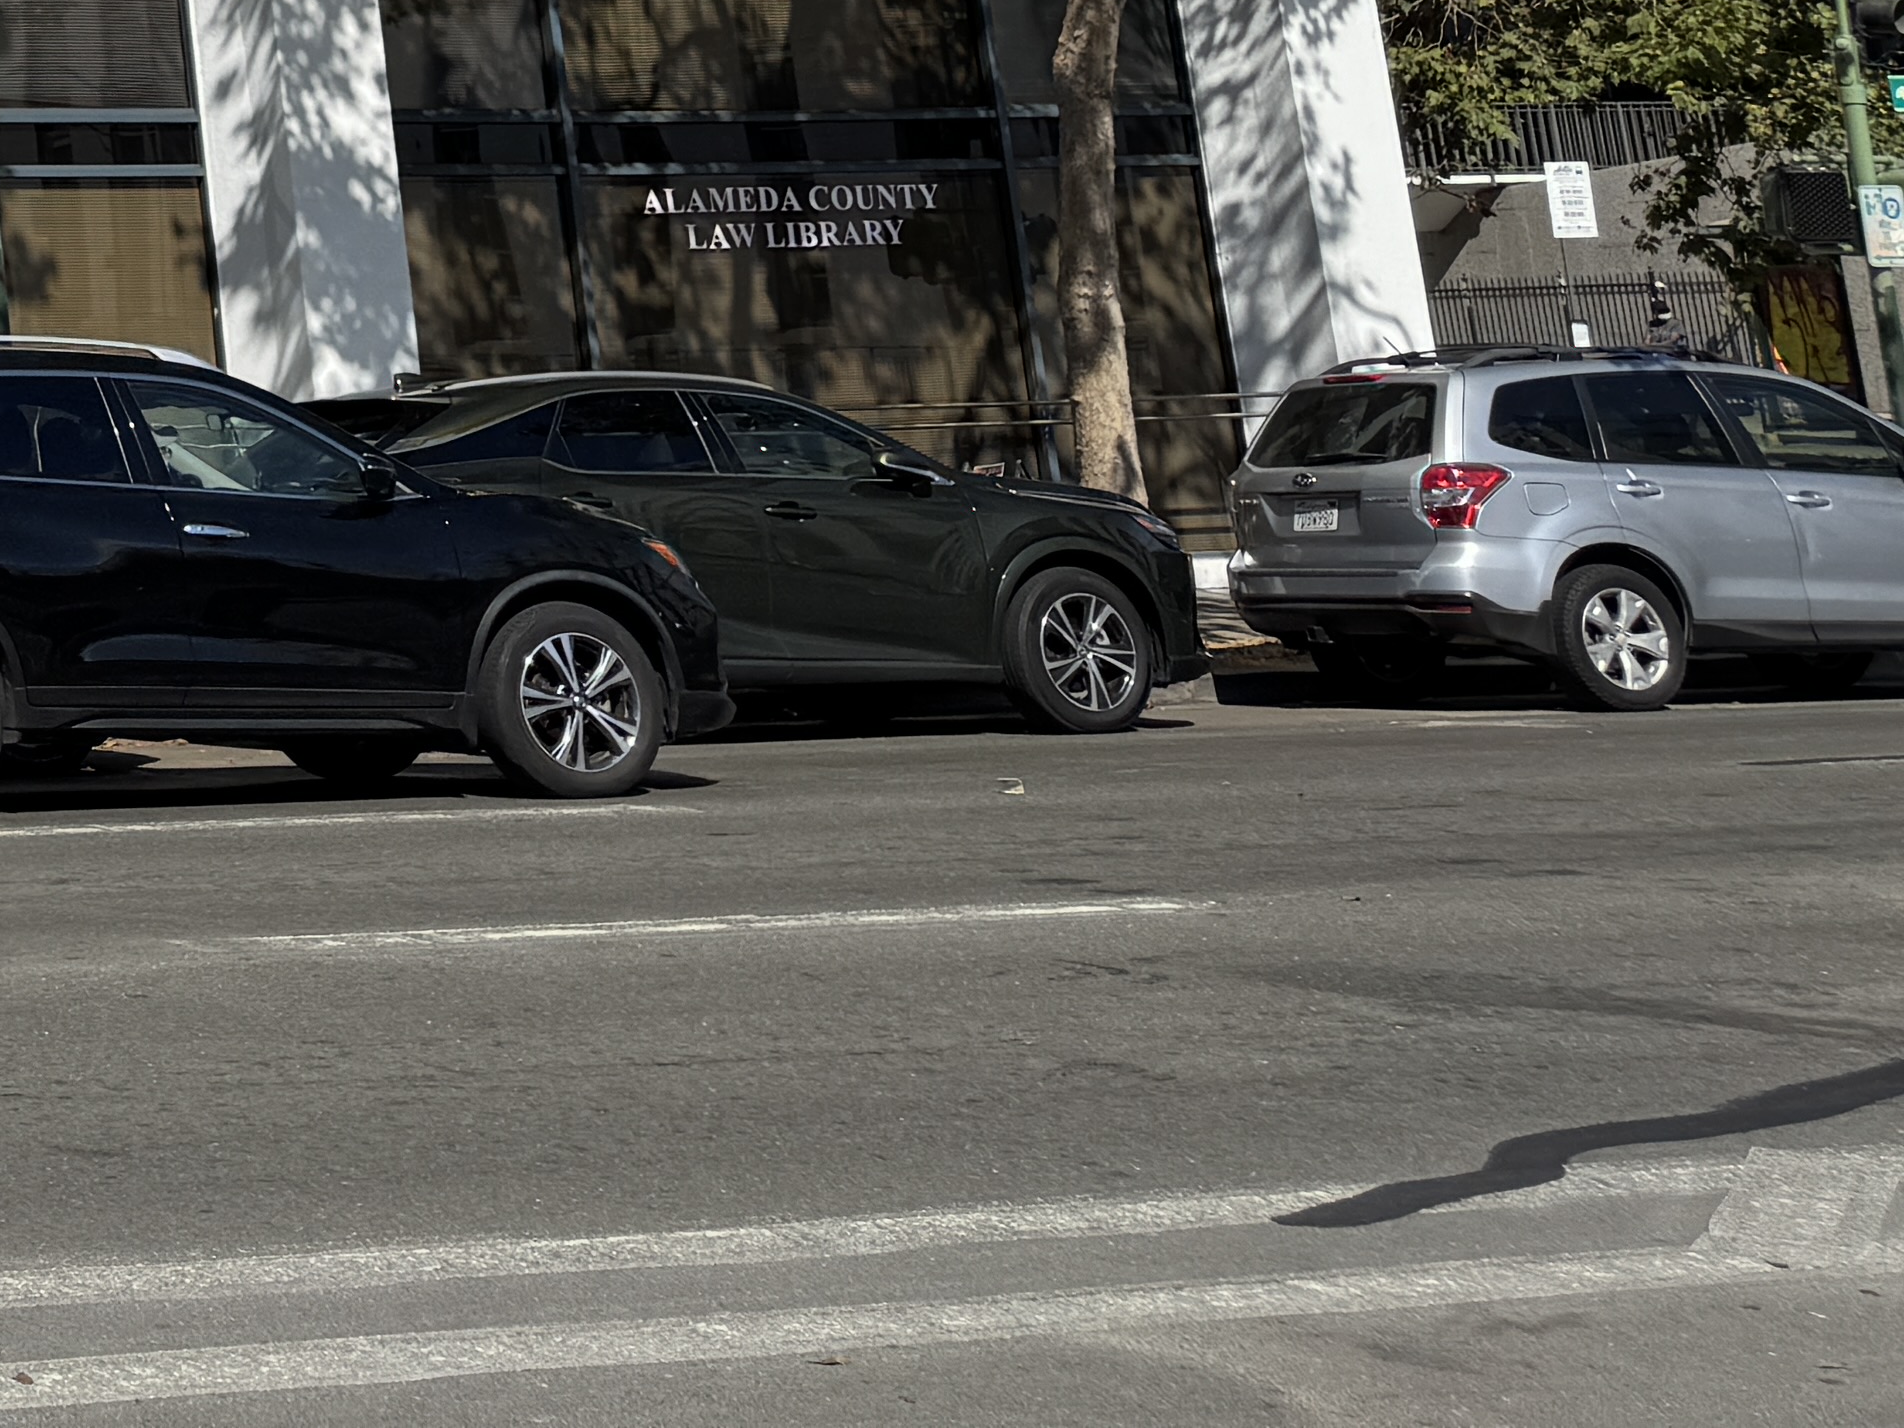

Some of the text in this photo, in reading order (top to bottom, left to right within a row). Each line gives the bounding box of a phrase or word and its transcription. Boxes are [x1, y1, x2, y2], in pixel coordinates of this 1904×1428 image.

[643, 184, 938, 214] ALAMEDA COUNTY
[685, 220, 903, 250] LAW LIBRARY
